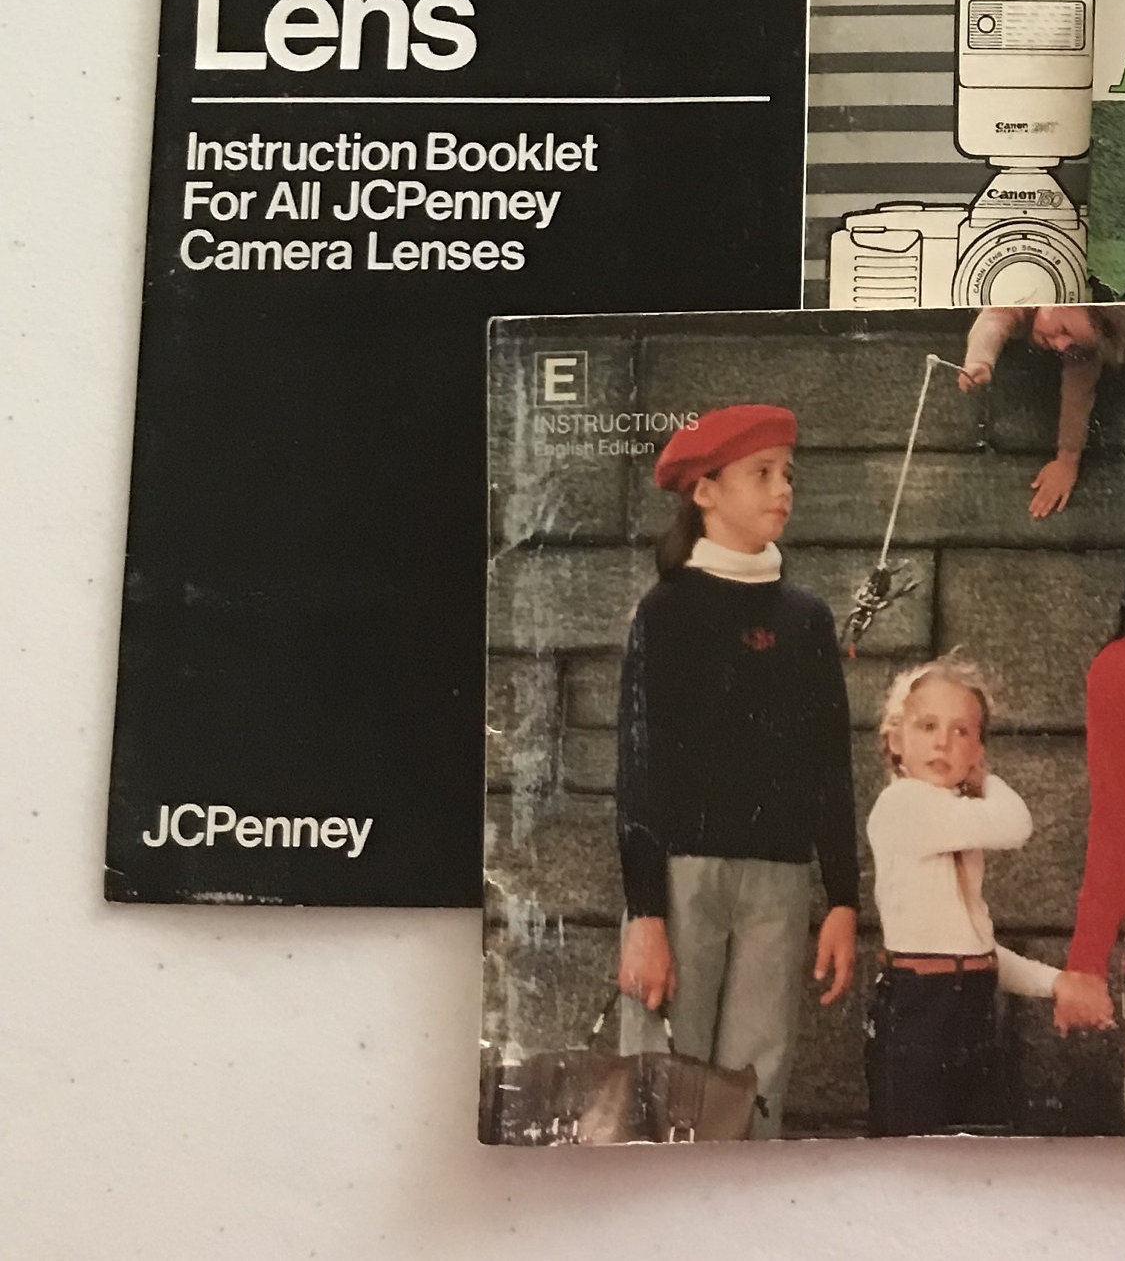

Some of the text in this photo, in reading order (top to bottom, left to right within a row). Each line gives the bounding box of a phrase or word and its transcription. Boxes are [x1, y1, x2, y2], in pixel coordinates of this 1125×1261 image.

[995, 121, 1028, 130] Canon
[187, 132, 599, 172] Instruction Booklet
[183, 179, 561, 229] For All JCPenney
[987, 189, 1036, 199] Canon
[180, 228, 525, 271] Camera Lenses
[544, 358, 577, 401] E
[534, 412, 700, 435] INSTRUCTIONS
[534, 439, 655, 459] English Edition
[143, 803, 374, 858] JCPenney
